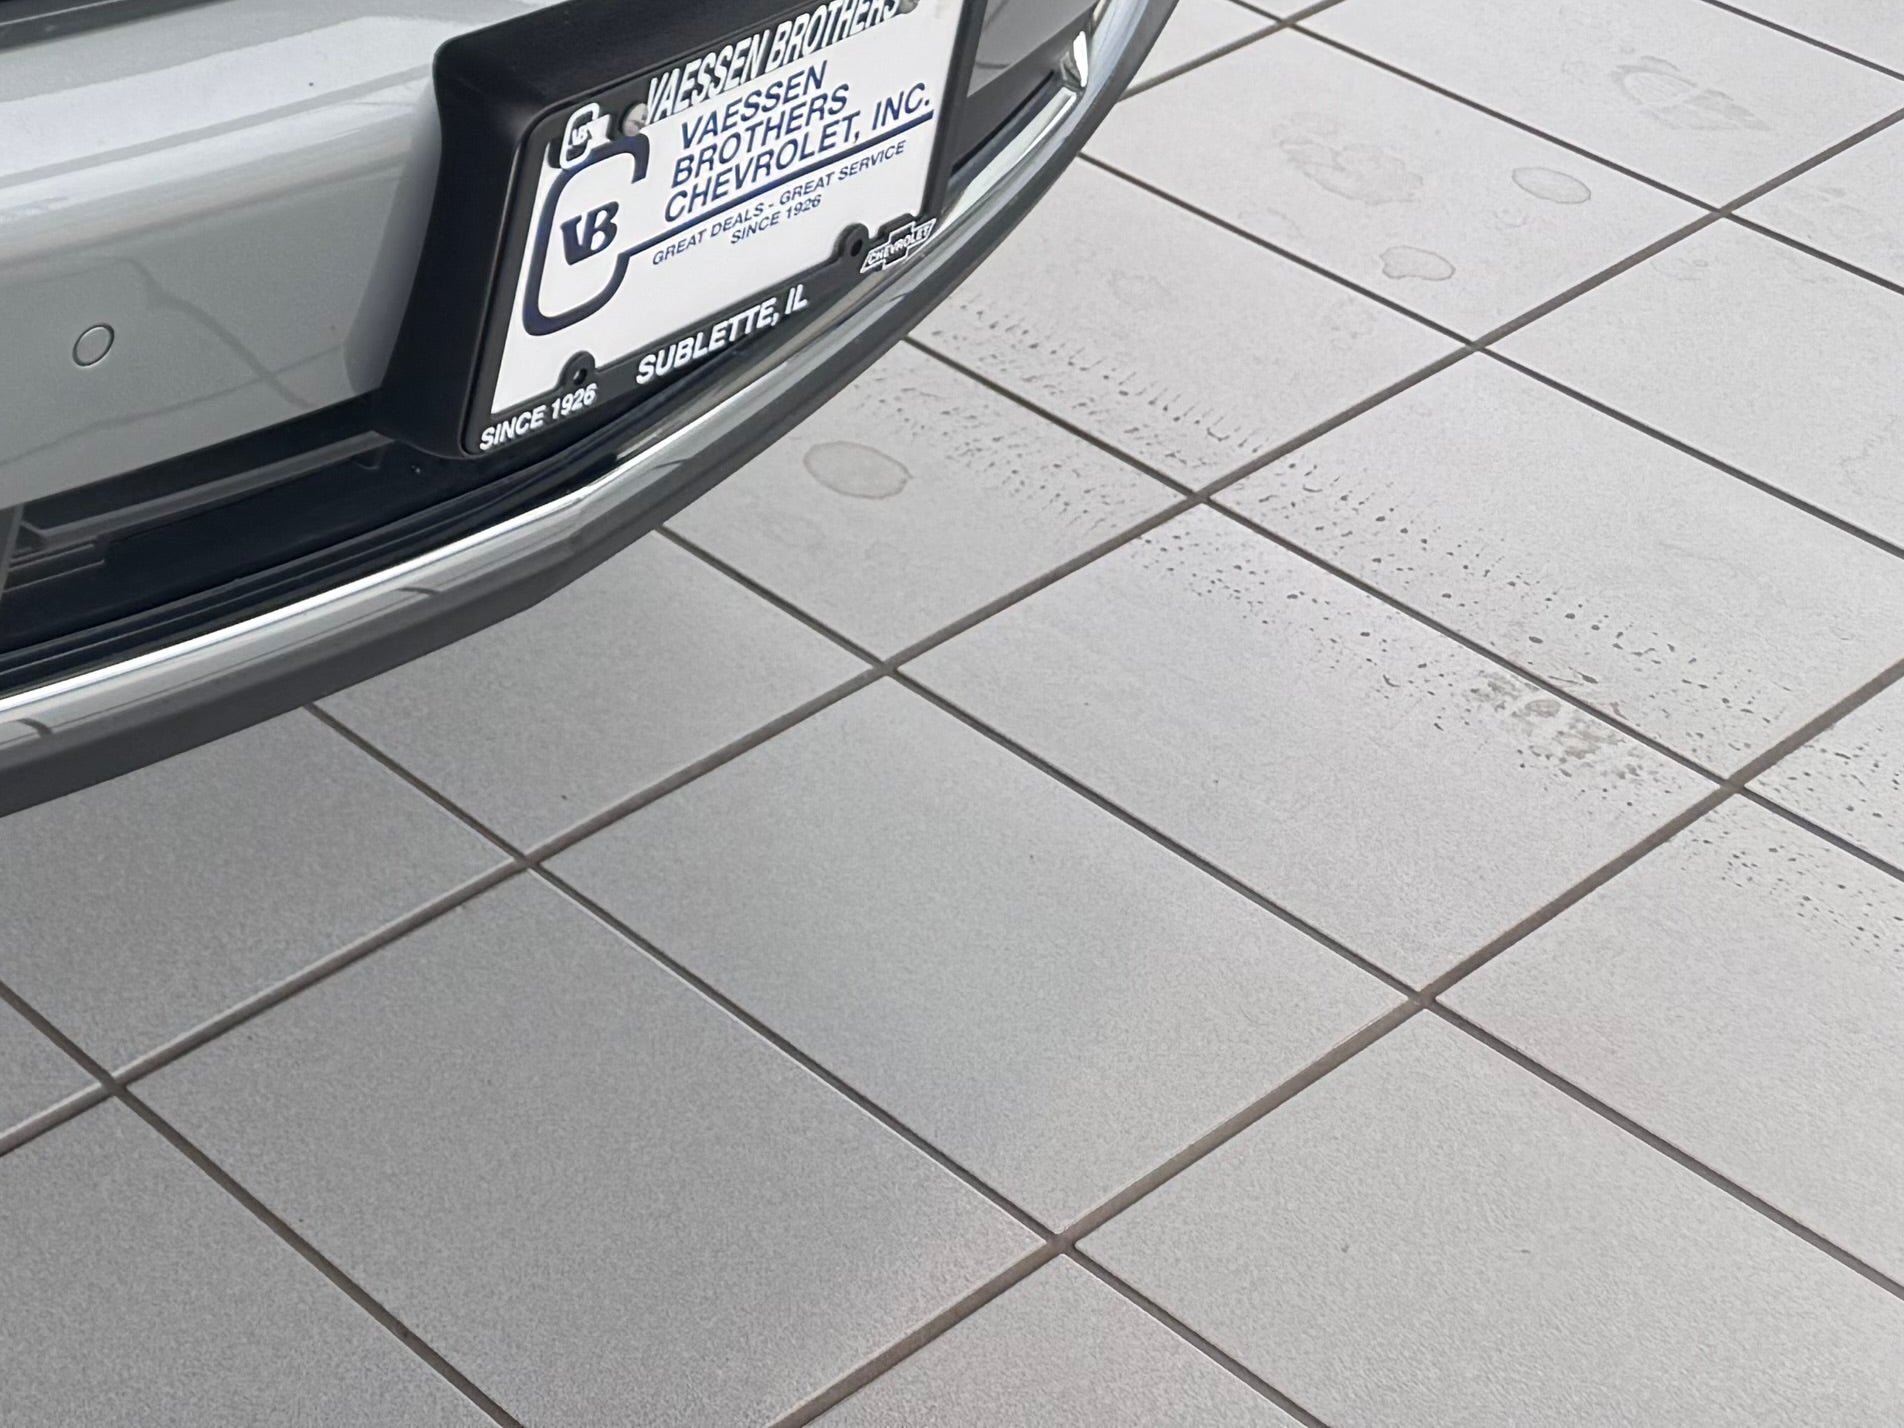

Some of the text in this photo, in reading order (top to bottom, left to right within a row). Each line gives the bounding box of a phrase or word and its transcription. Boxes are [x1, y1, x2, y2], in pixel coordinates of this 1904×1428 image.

[664, 82, 930, 223] CHEVROLET, INC.
[671, 83, 850, 189] BROTHERS
[681, 60, 828, 150] VAESSEN
[652, 229, 707, 266] GREAT
[710, 202, 765, 237] DEALS
[779, 172, 833, 205] GREAT
[837, 140, 907, 181] SERVICE
[731, 194, 822, 245] SINCE 1926
[868, 224, 931, 265] CHEVROLET
[636, 284, 808, 385] SUBLETTE, IL
[480, 382, 599, 451] SINCE 1926
